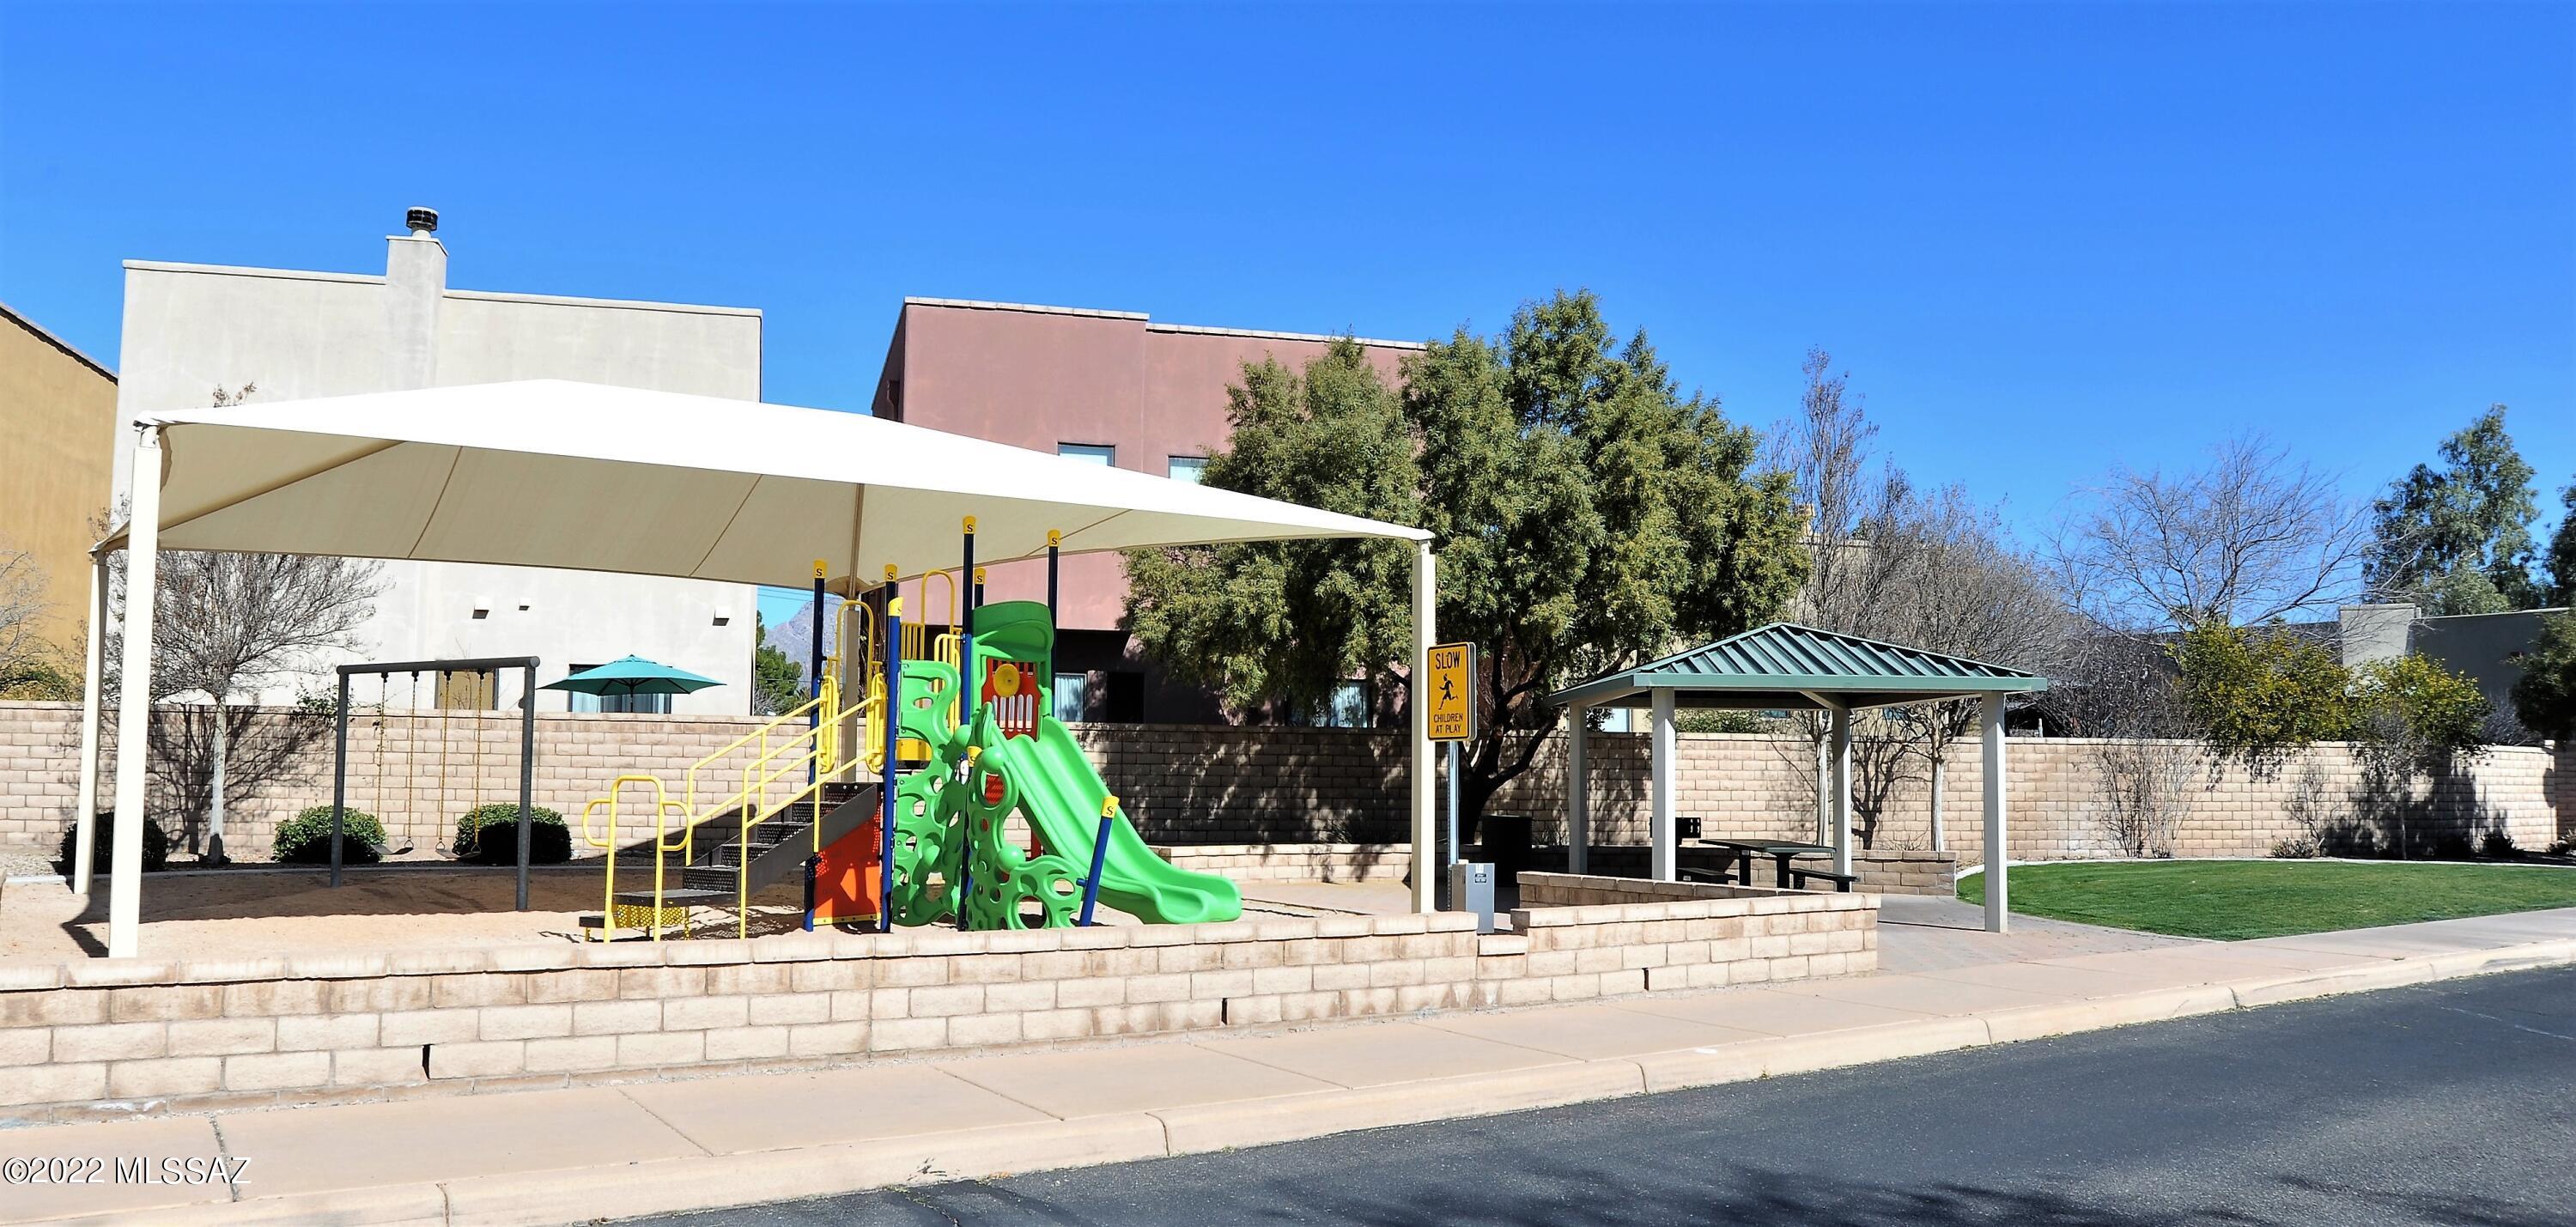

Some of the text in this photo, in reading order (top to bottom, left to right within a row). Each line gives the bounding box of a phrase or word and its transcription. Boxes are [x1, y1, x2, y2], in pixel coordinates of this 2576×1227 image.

[967, 524, 974, 532] S
[1051, 537, 1058, 545] S
[816, 568, 823, 577] S
[887, 571, 894, 580] S
[976, 574, 983, 583] S
[1435, 651, 1461, 670] SLOW
[1433, 713, 1463, 723] CHILDREN
[1435, 724, 1461, 733] AT PLAY
[1107, 805, 1114, 816] S
